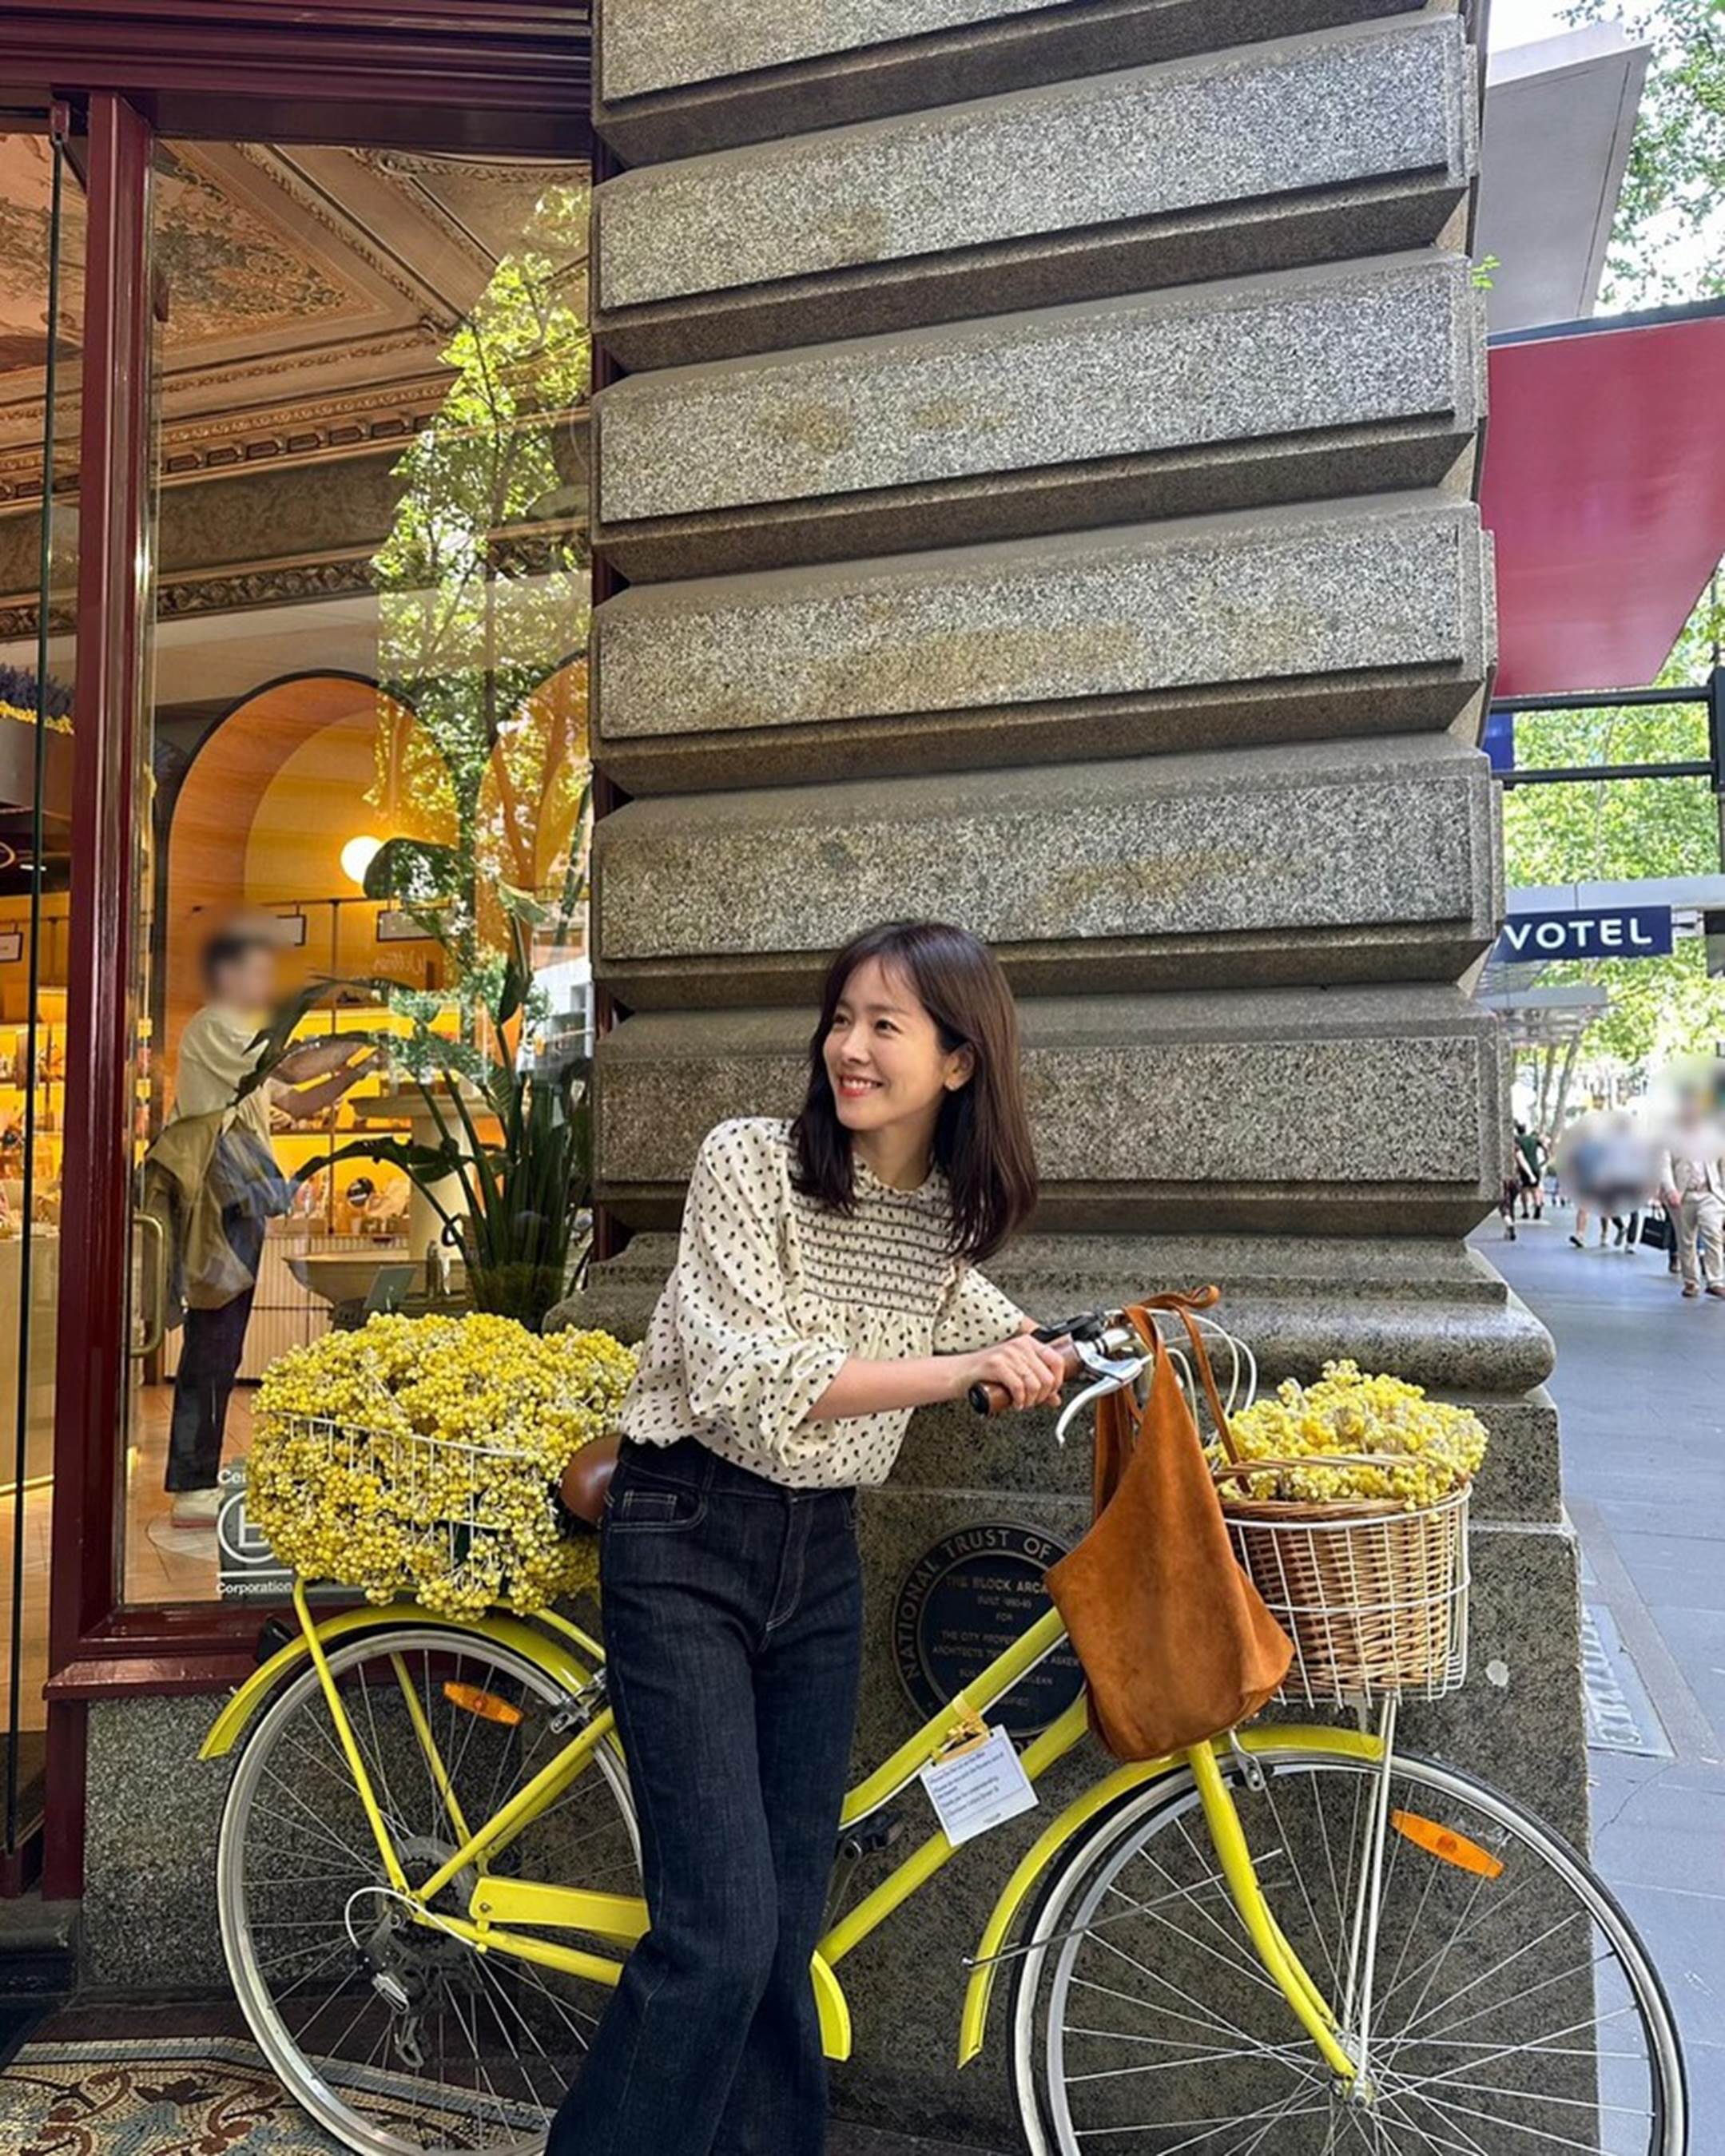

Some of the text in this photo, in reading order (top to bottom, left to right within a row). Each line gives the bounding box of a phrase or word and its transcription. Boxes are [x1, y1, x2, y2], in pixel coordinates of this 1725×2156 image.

[1494, 918, 1652, 951] VOTEL
[216, 1581, 292, 1595] Corporation
[972, 1578, 1012, 1592] BLOCK
[1016, 1580, 1048, 1594] ARCA
[898, 1529, 1052, 1678] NATIONAL TRUST OF
